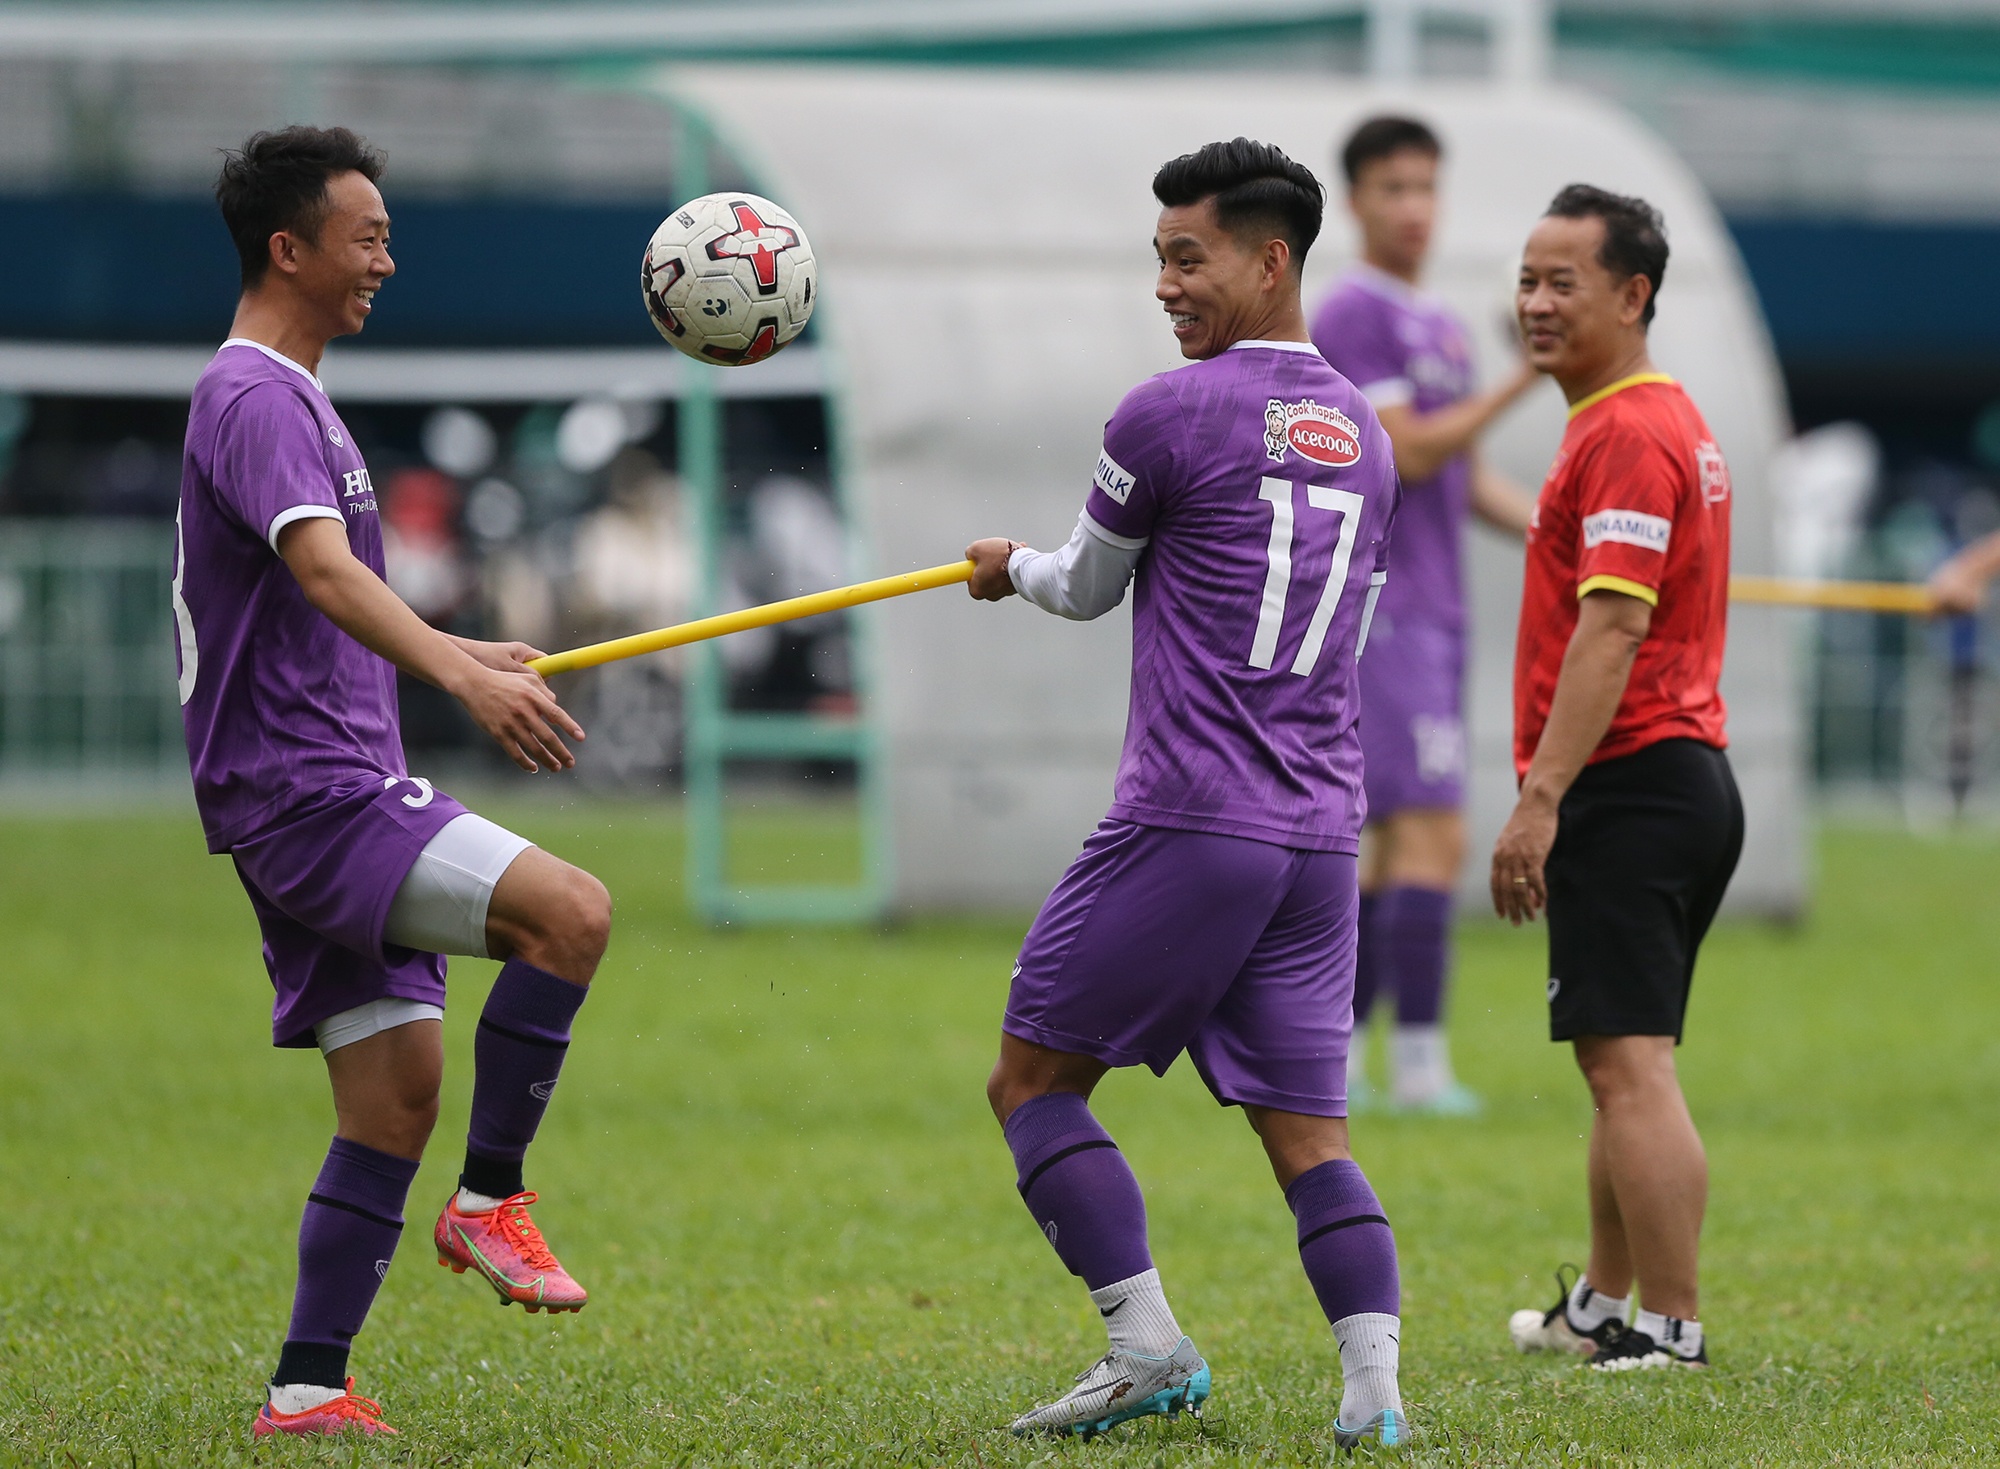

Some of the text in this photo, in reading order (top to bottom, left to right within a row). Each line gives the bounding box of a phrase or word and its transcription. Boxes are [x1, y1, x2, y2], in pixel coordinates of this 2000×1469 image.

[1286, 402, 1359, 436] Cook happiness
[1585, 517, 1669, 543] VINAMILK
[1248, 475, 1365, 678] 17
